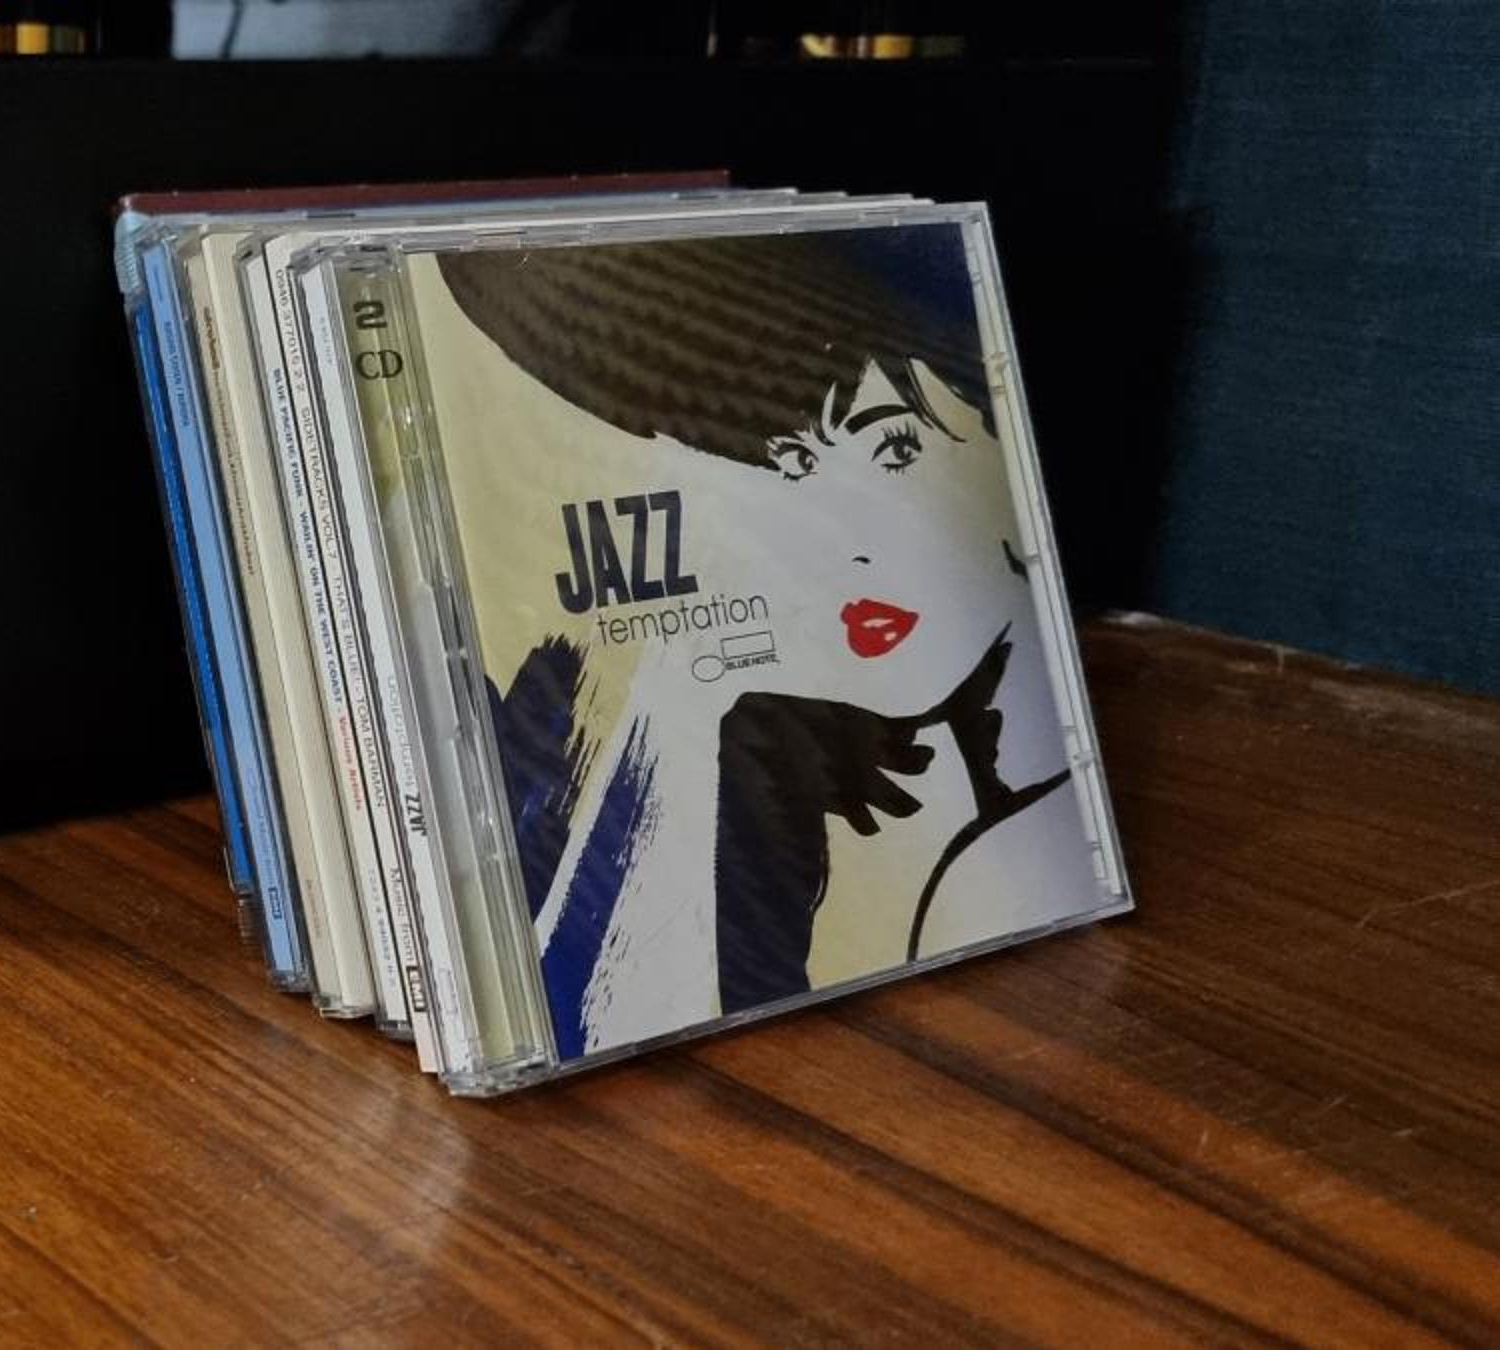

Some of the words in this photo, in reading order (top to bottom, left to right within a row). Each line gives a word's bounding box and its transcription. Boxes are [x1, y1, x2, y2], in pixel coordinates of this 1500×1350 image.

[353, 300, 388, 330] 2
[356, 349, 402, 380] CD
[555, 490, 699, 614] JAZZ
[598, 593, 769, 645] temptation
[356, 696, 371, 733] TOM
[404, 792, 428, 837] JAZZ
